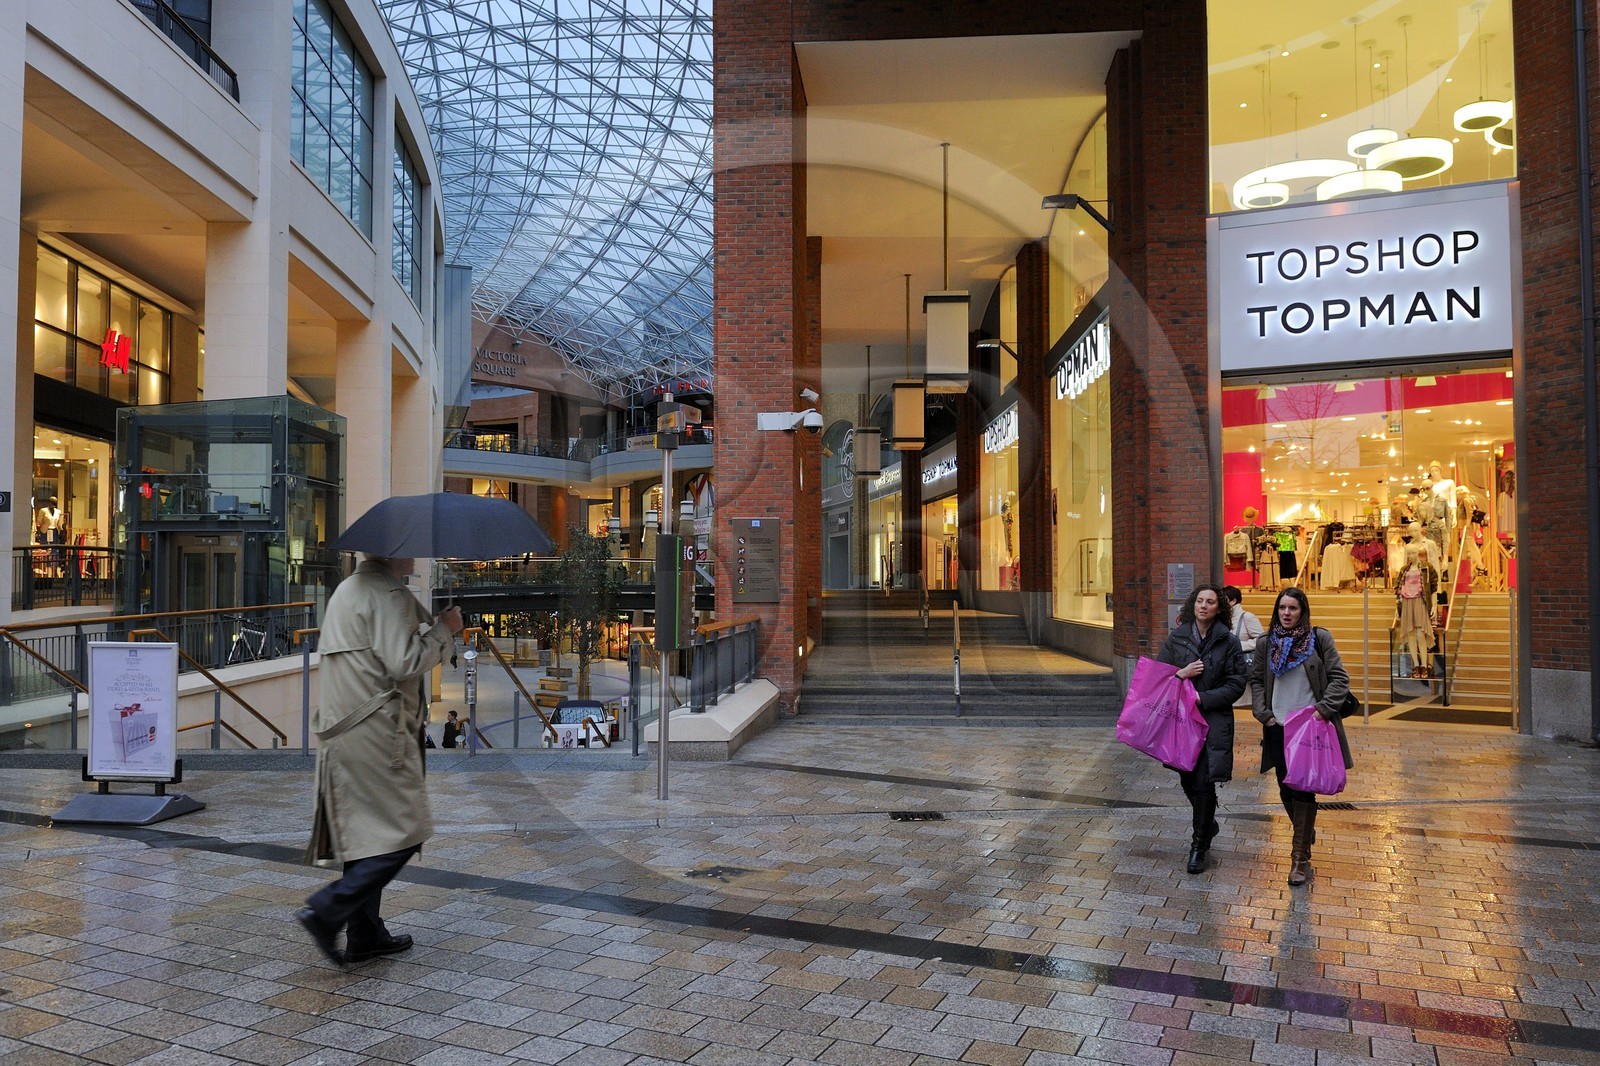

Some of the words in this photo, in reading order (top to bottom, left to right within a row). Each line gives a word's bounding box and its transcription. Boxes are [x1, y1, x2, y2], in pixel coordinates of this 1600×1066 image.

[1246, 230, 1479, 284] TOPSHOP
[1246, 286, 1481, 338] TOPMAN
[475, 347, 528, 366] VICTORIA
[474, 361, 516, 378] SQUARE
[687, 545, 694, 561] G
